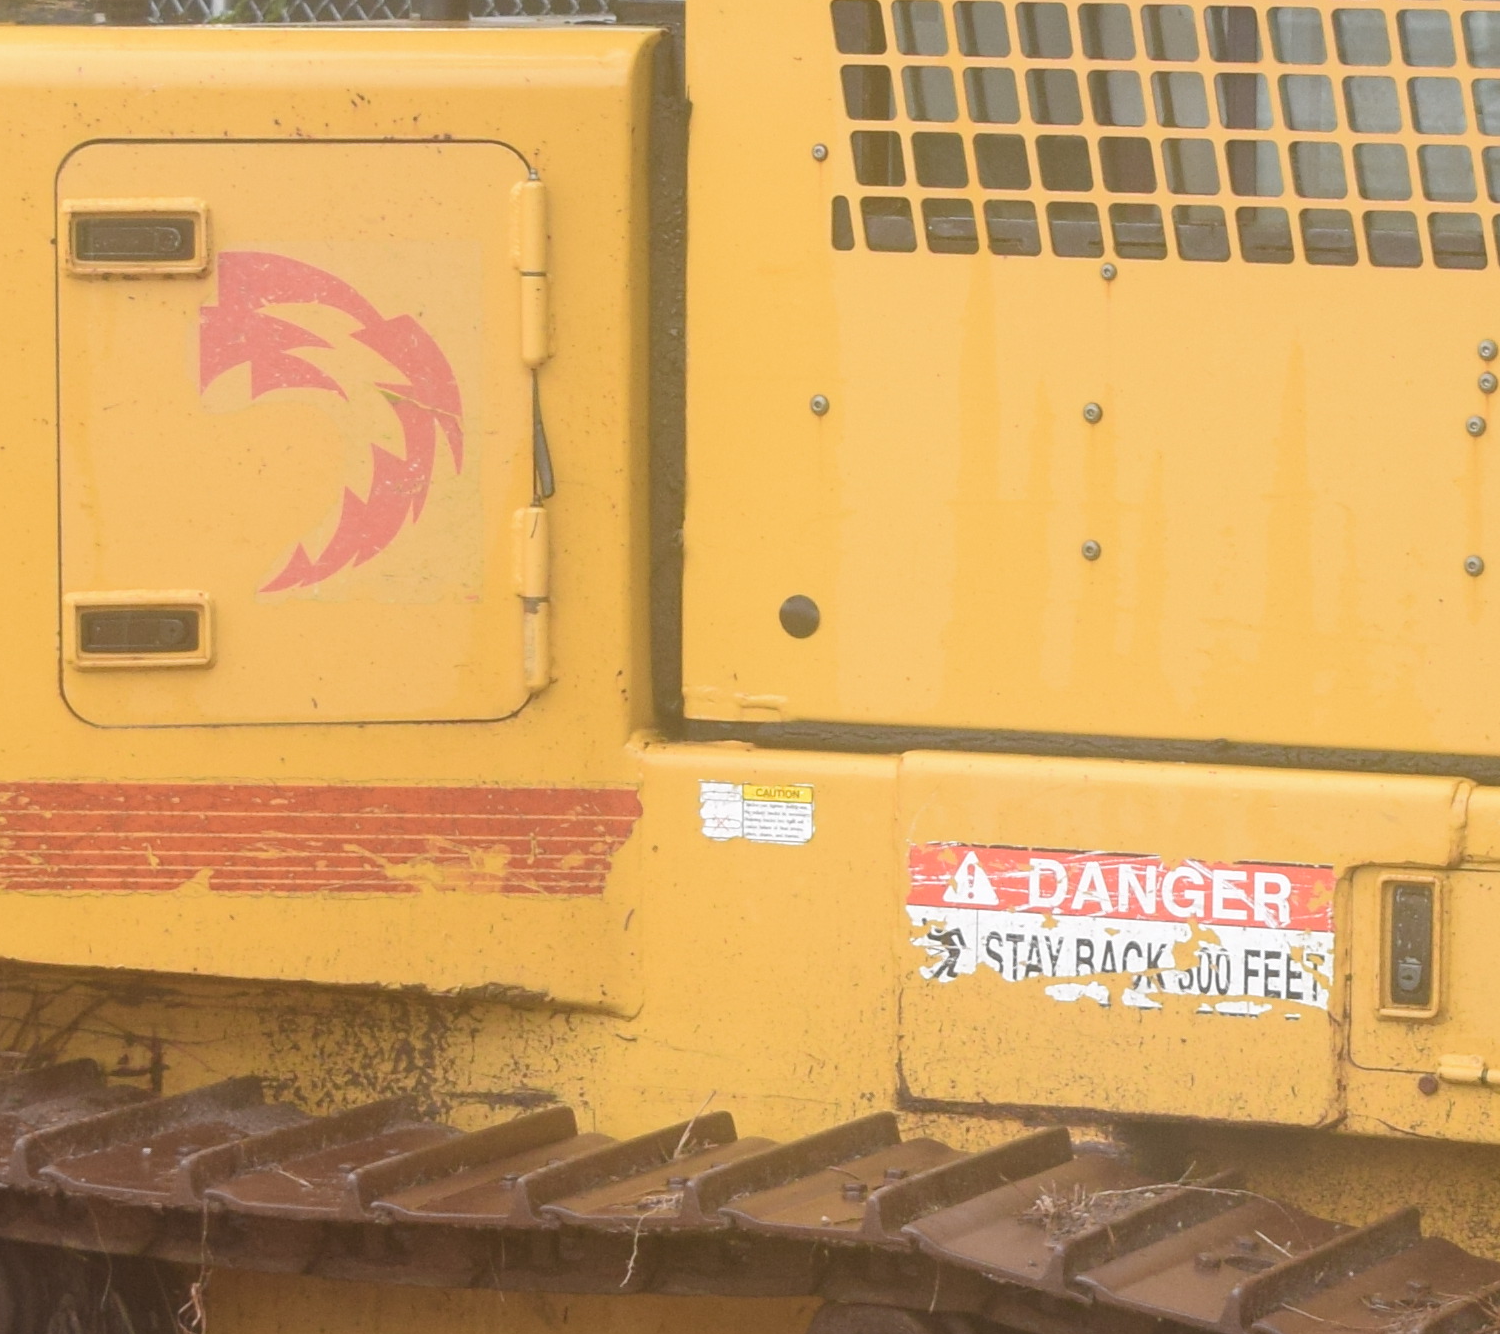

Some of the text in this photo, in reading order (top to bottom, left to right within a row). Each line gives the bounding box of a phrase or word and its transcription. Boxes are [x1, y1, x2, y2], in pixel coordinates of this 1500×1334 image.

[755, 788, 800, 799] CAUTION
[1028, 857, 1293, 923] DANGER
[986, 931, 1064, 981] STAY
[1076, 938, 1168, 990] BACK
[1243, 949, 1326, 1001] FEET
